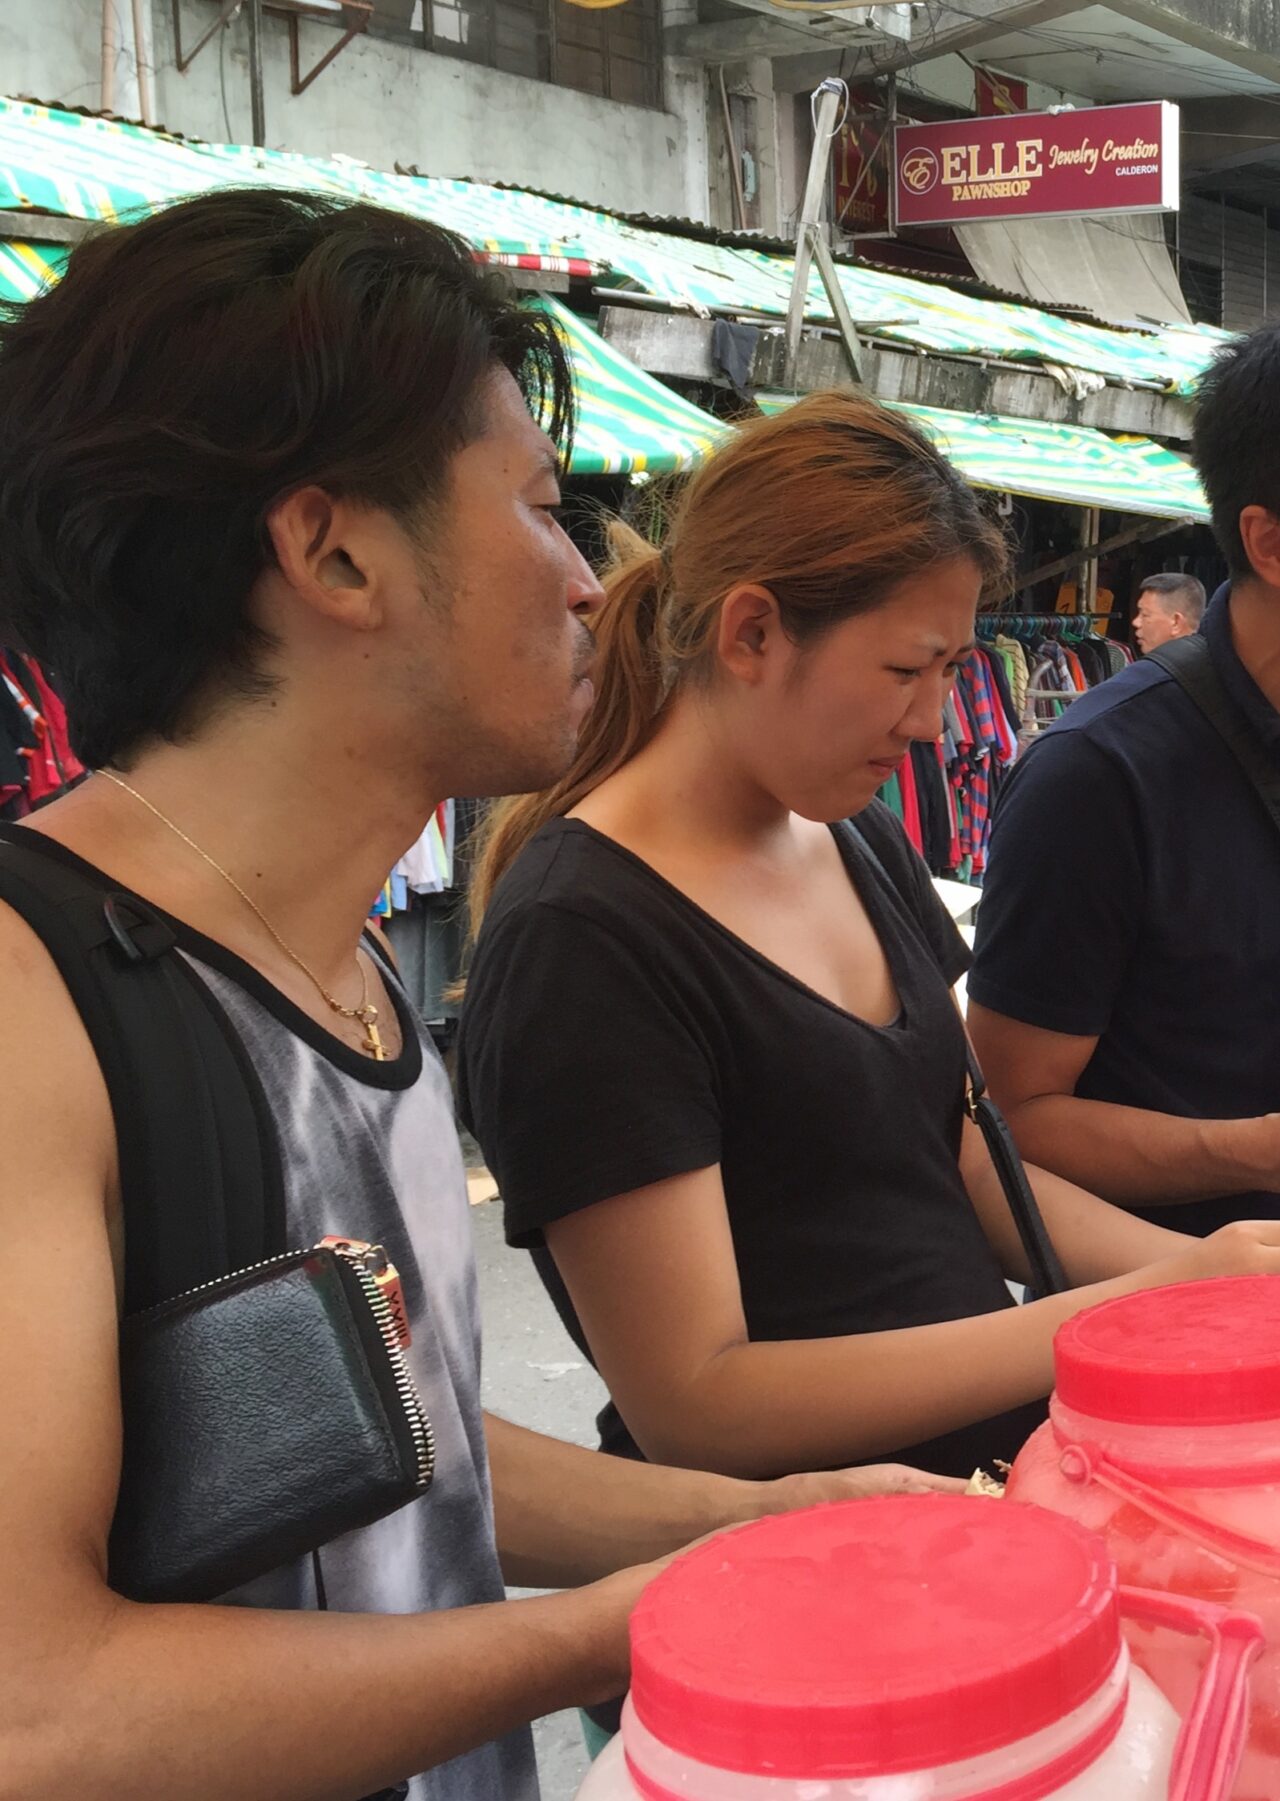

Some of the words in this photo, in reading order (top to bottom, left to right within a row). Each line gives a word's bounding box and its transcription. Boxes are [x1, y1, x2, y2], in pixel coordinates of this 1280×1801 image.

[941, 139, 1043, 185] ELLE
[1048, 137, 1099, 175] Jewelry
[1102, 137, 1159, 162] Creation
[1115, 164, 1159, 177] CALDERON
[952, 180, 1032, 202] PAWNSHOP
